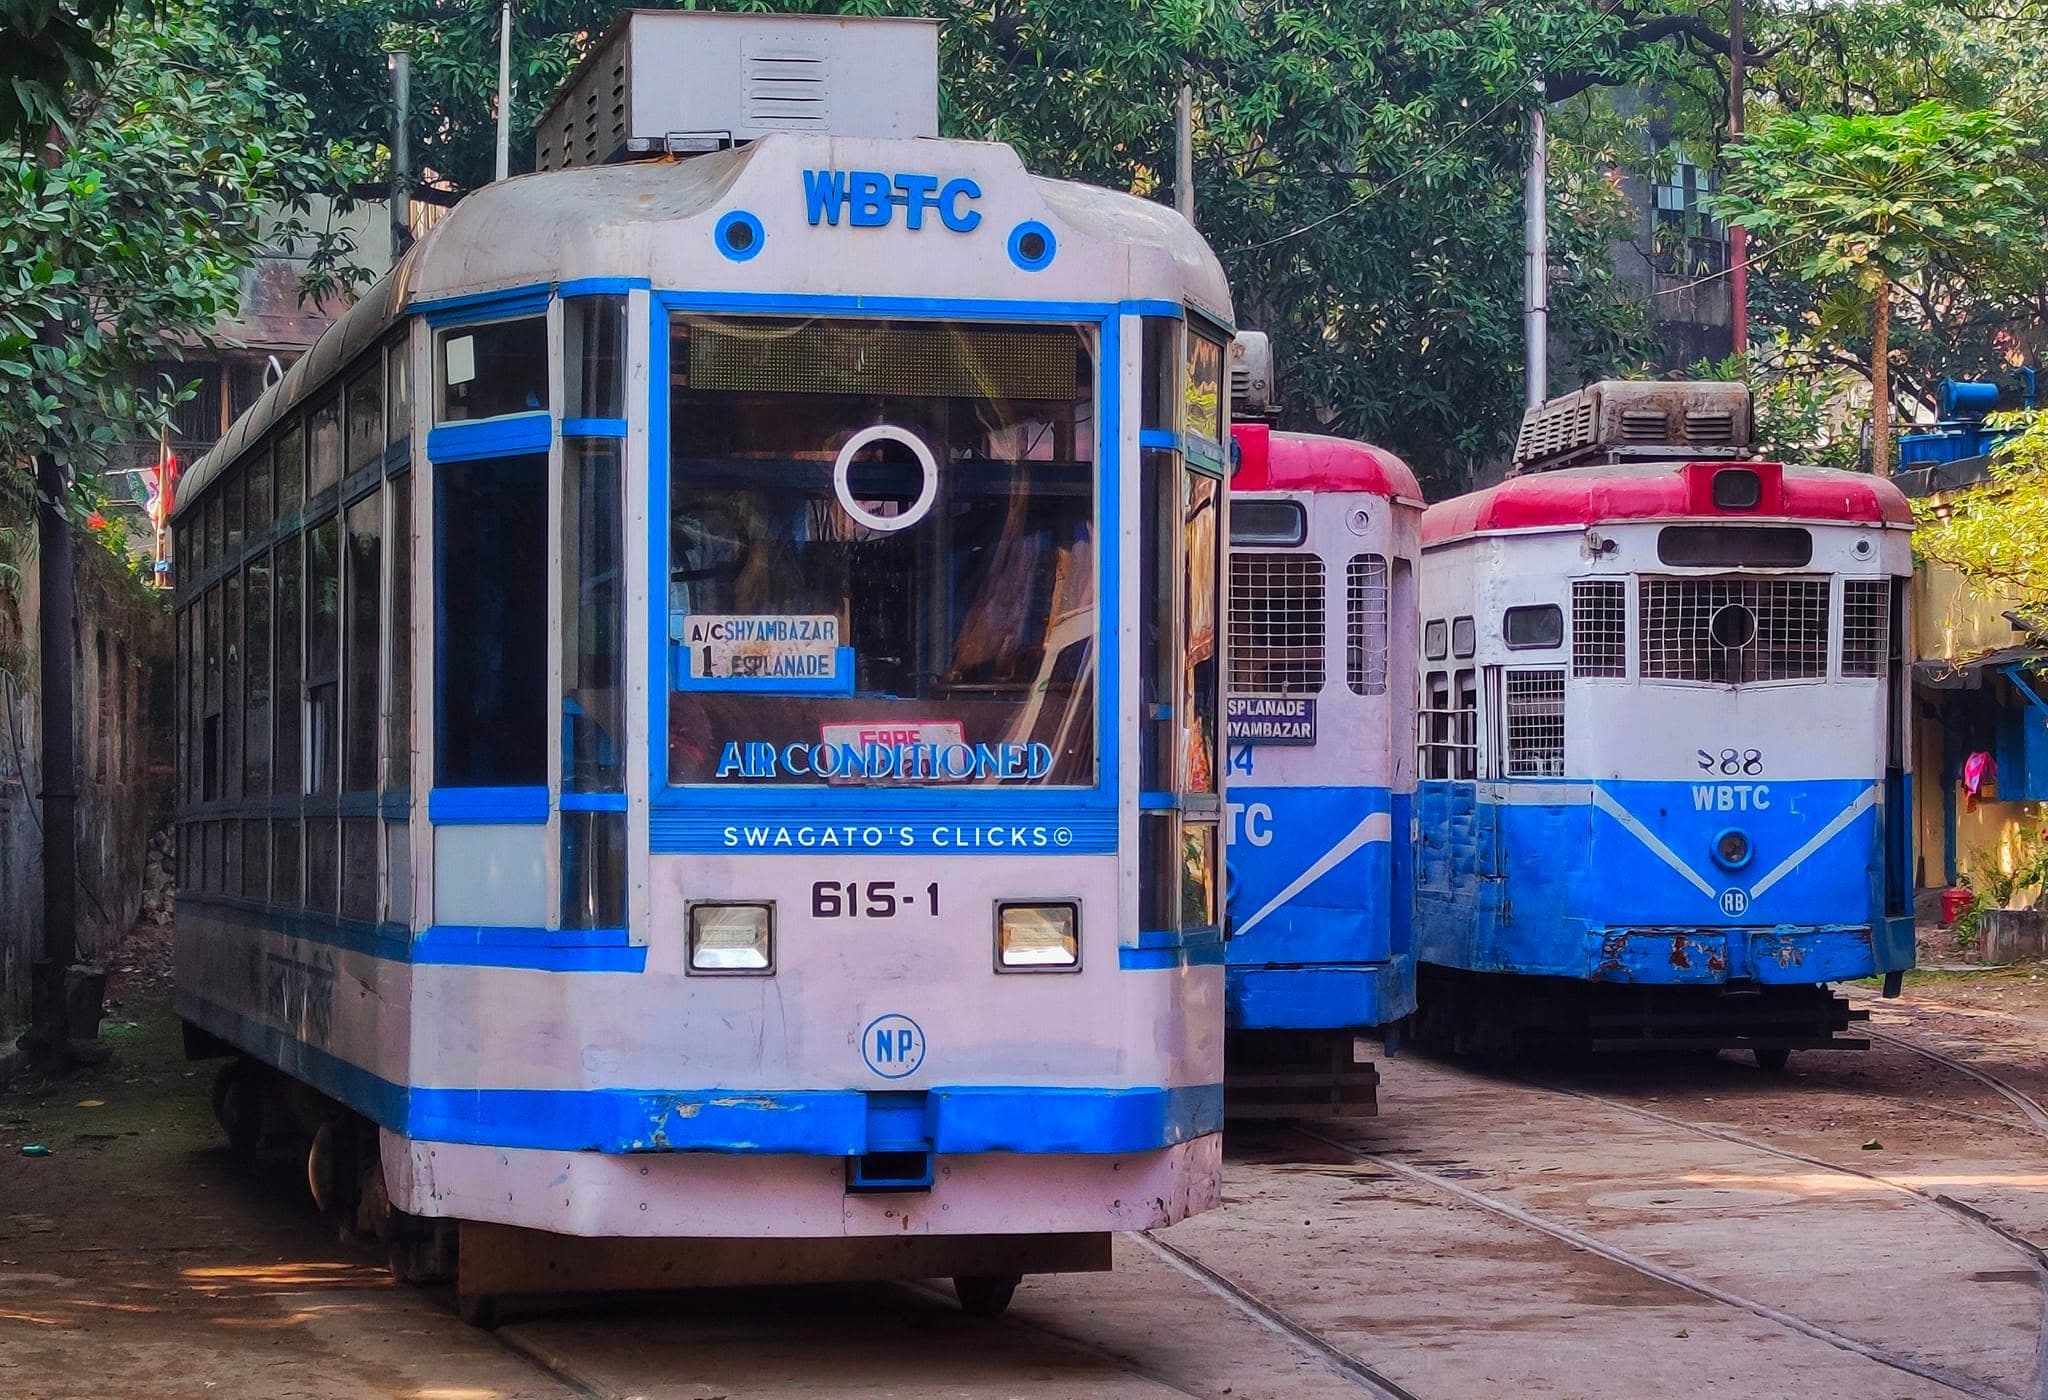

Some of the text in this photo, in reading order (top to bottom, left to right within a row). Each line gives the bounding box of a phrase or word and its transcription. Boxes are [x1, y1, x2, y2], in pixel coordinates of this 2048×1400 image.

[803, 169, 982, 233] WBTC
[724, 620, 835, 642] SHYAMBAZAR
[731, 654, 829, 678] ESPLANADE
[715, 741, 776, 778] AIR
[779, 741, 1053, 779] CONDITIONED
[1692, 785, 1770, 811] WBTC
[812, 881, 939, 918] 615-1
[876, 1030, 914, 1062] NP
